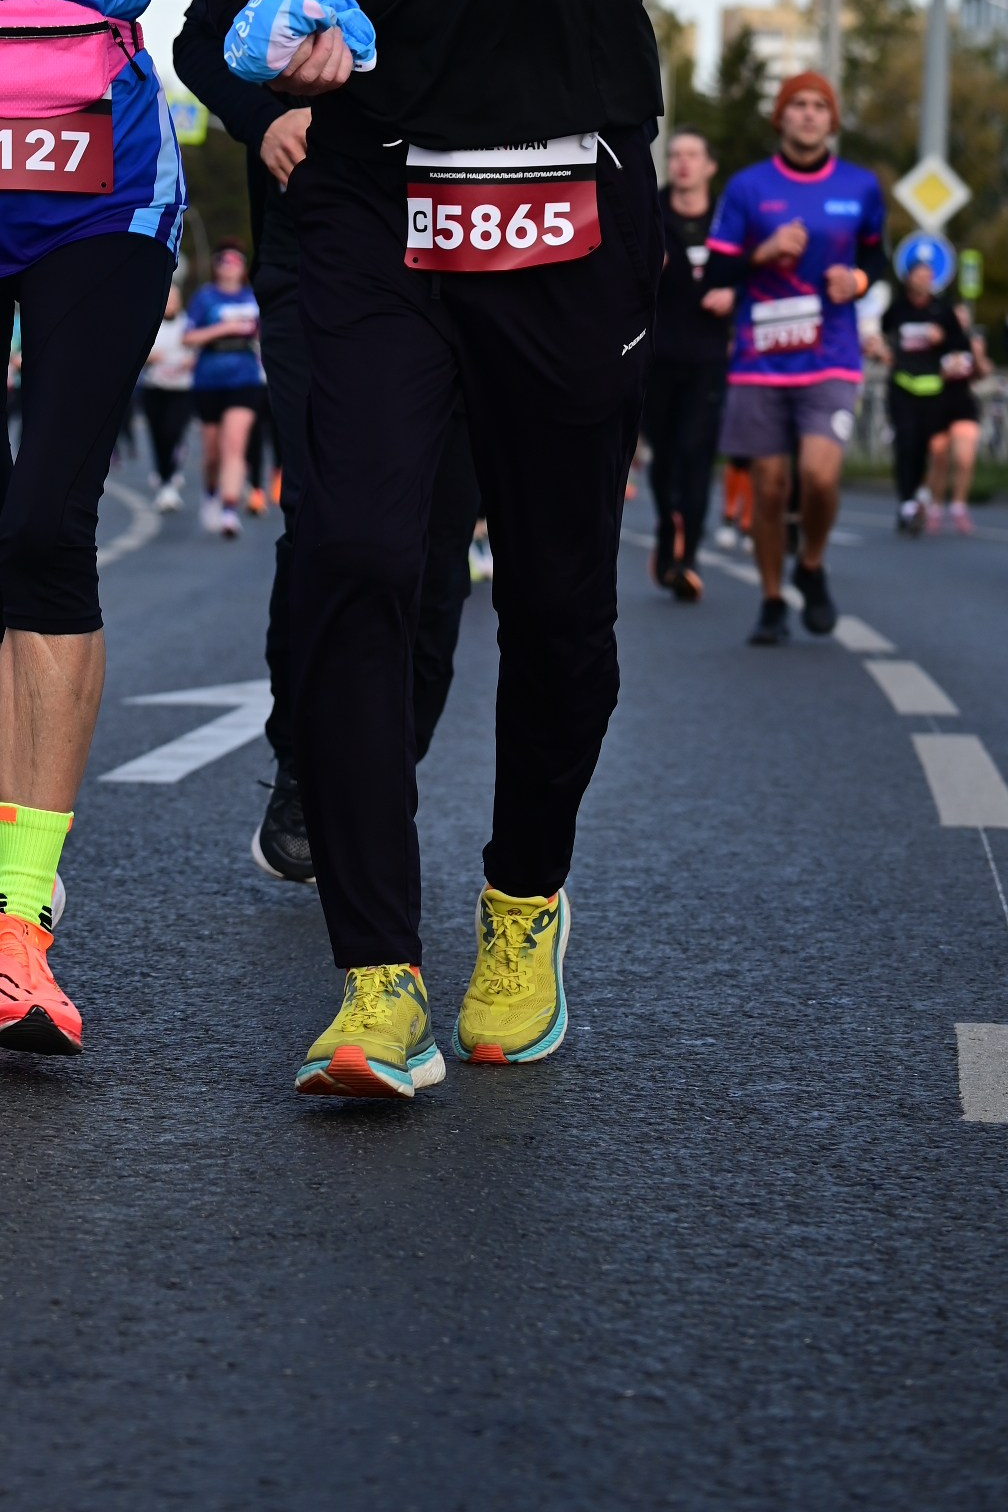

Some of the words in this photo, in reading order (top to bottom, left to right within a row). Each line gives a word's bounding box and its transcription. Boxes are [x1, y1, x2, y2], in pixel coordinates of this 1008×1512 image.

[466, 171, 524, 180] НАЦИОНАЛЬНЫЙ
[523, 170, 572, 179] ПОЛУМАРАФОН
[412, 210, 428, 233] C
[434, 201, 575, 251] 5865
